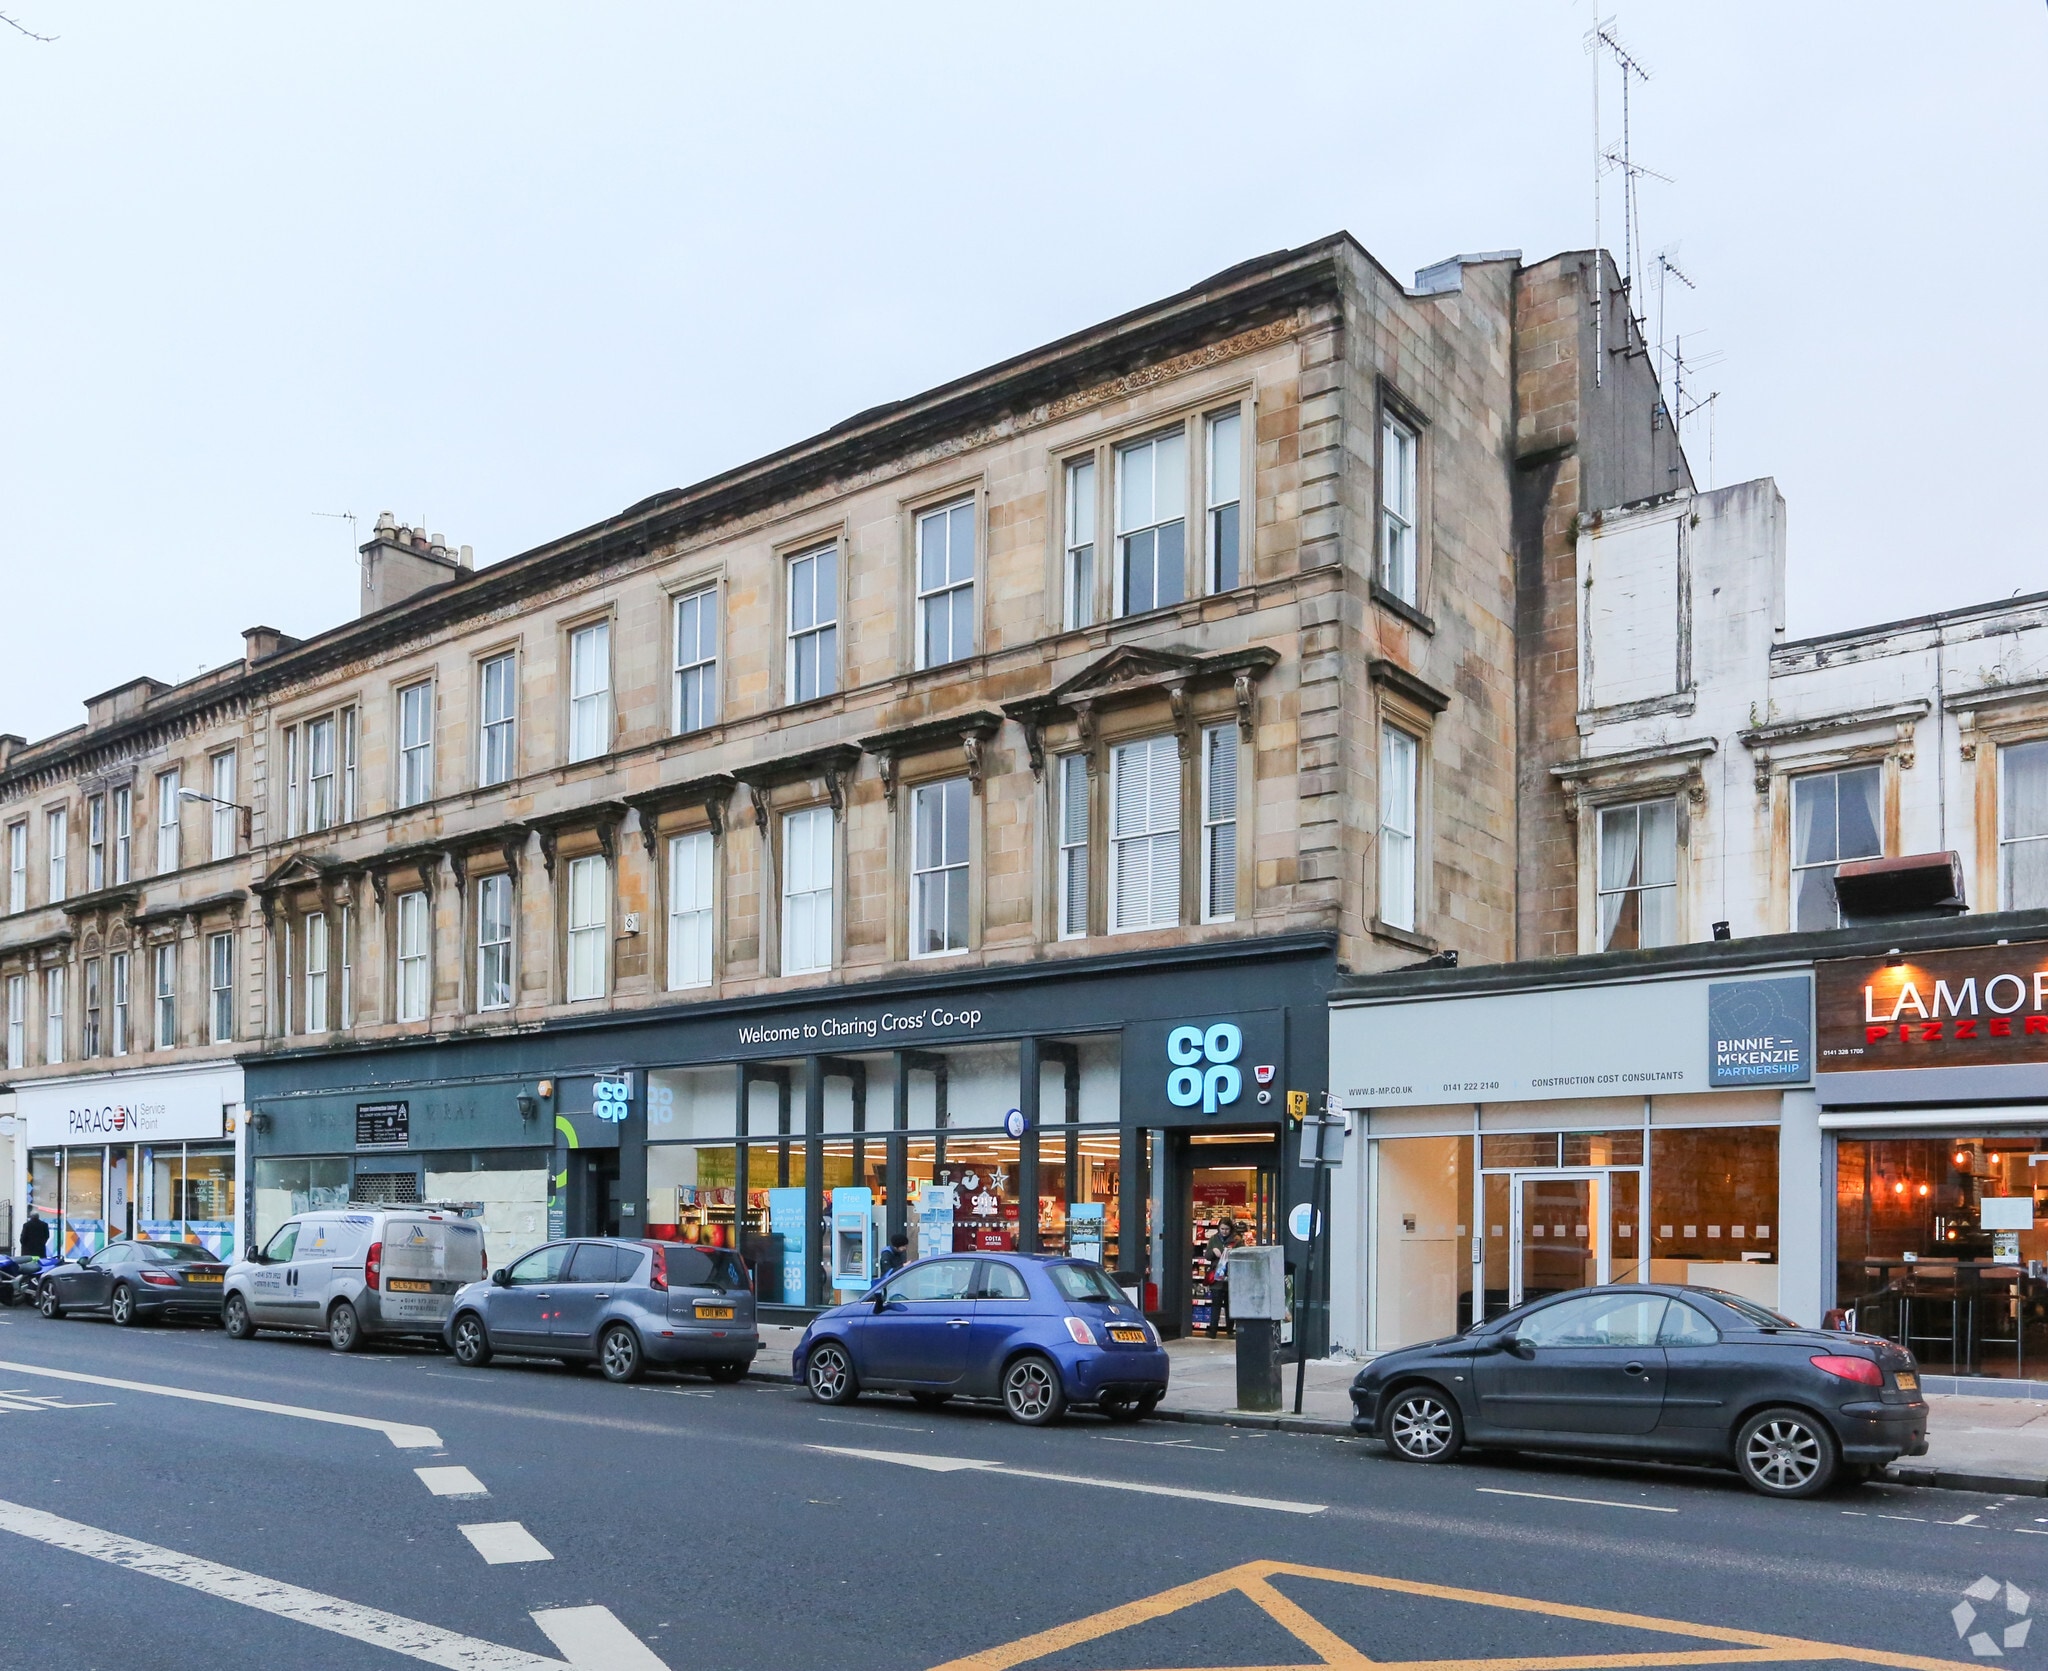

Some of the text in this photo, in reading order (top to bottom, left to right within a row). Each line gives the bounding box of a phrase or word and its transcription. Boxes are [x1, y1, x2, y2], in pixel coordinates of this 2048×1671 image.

[738, 1027, 800, 1044] Welcome
[803, 1025, 817, 1039] to
[821, 1017, 877, 1037] Charing
[931, 1008, 981, 1029] Co-op
[1717, 1037, 1774, 1052] BINNIE
[1717, 1064, 1799, 1077] PARTNERSHIP
[1531, 1071, 1684, 1088] CONSTRUCTION COST CONSULTANTS
[1348, 1085, 1413, 1096] WWW.B-MP.CO.UK
[1443, 1081, 1500, 1092] 0141 222 2140
[140, 1103, 165, 1116] Service
[69, 1104, 138, 1134] PARAGON
[140, 1118, 158, 1130] Point
[843, 1193, 860, 1203] Free
